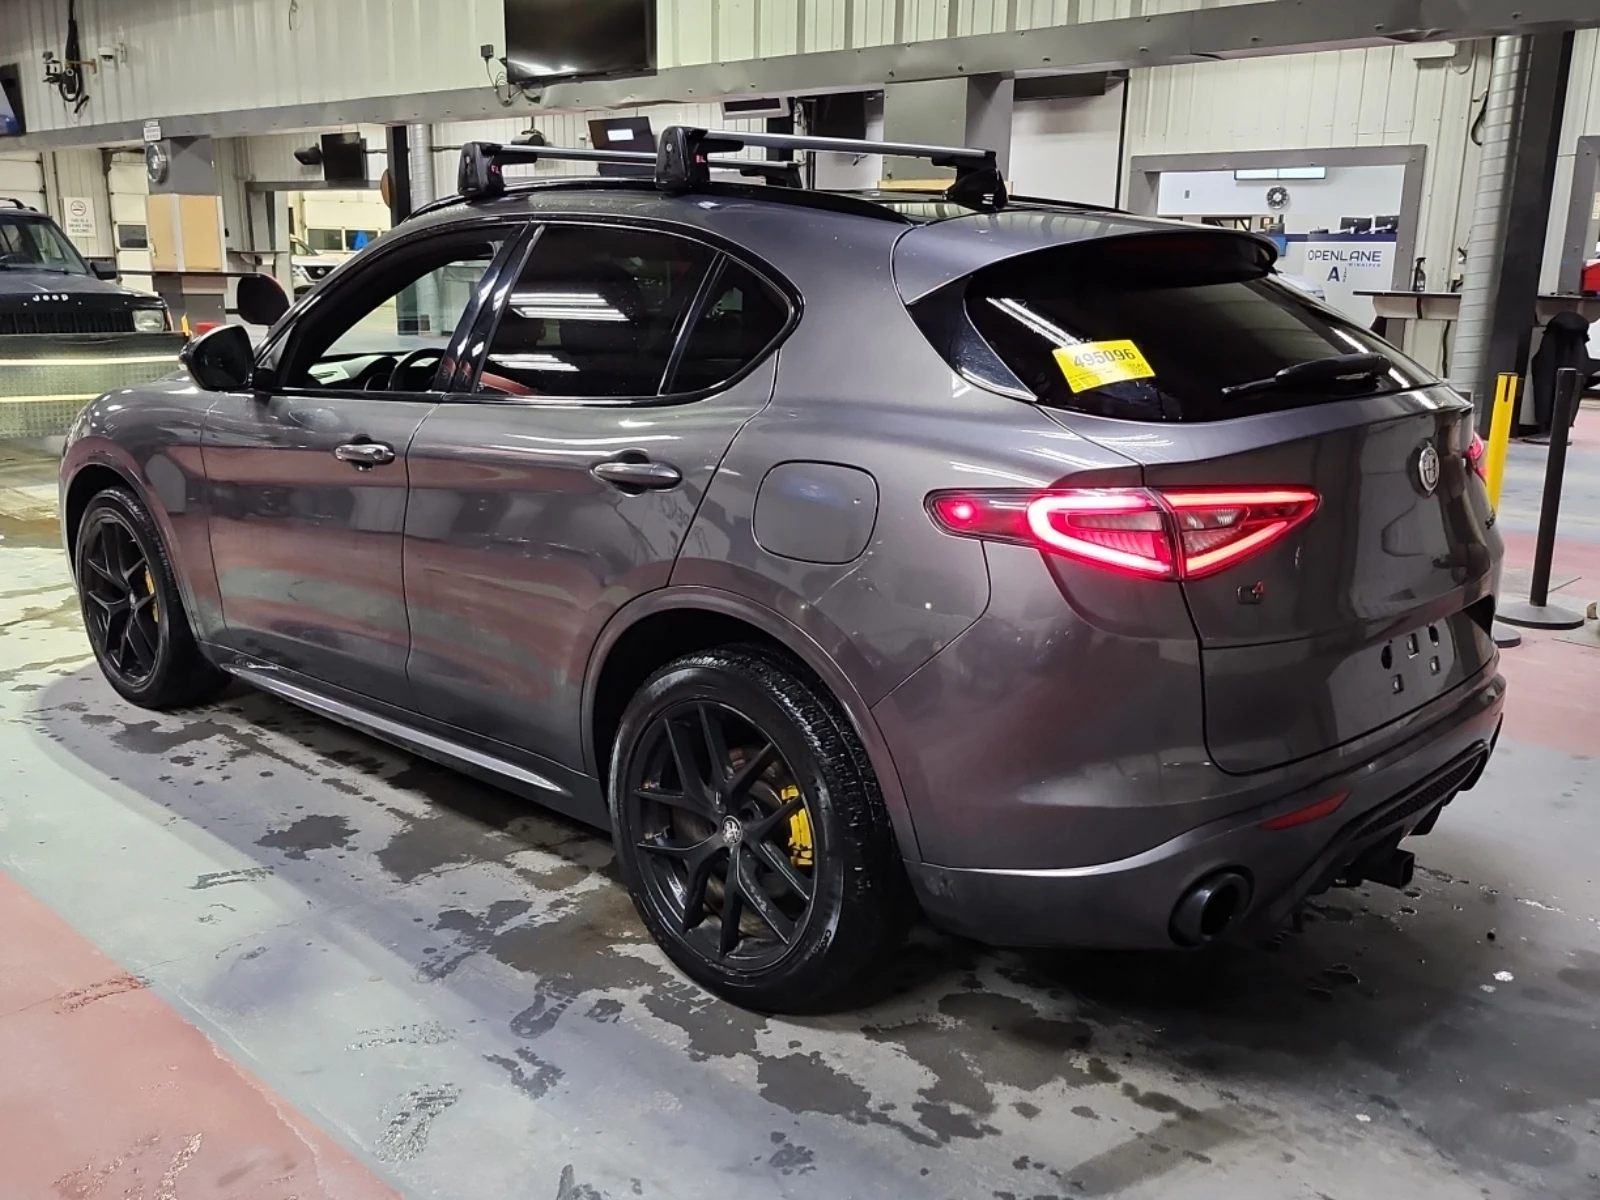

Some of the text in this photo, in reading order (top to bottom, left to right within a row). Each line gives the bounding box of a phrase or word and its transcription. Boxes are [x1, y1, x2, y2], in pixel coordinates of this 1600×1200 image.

[1307, 249, 1382, 262] OPENLANE
[1326, 266, 1340, 282] A
[1073, 348, 1137, 368] 495096
